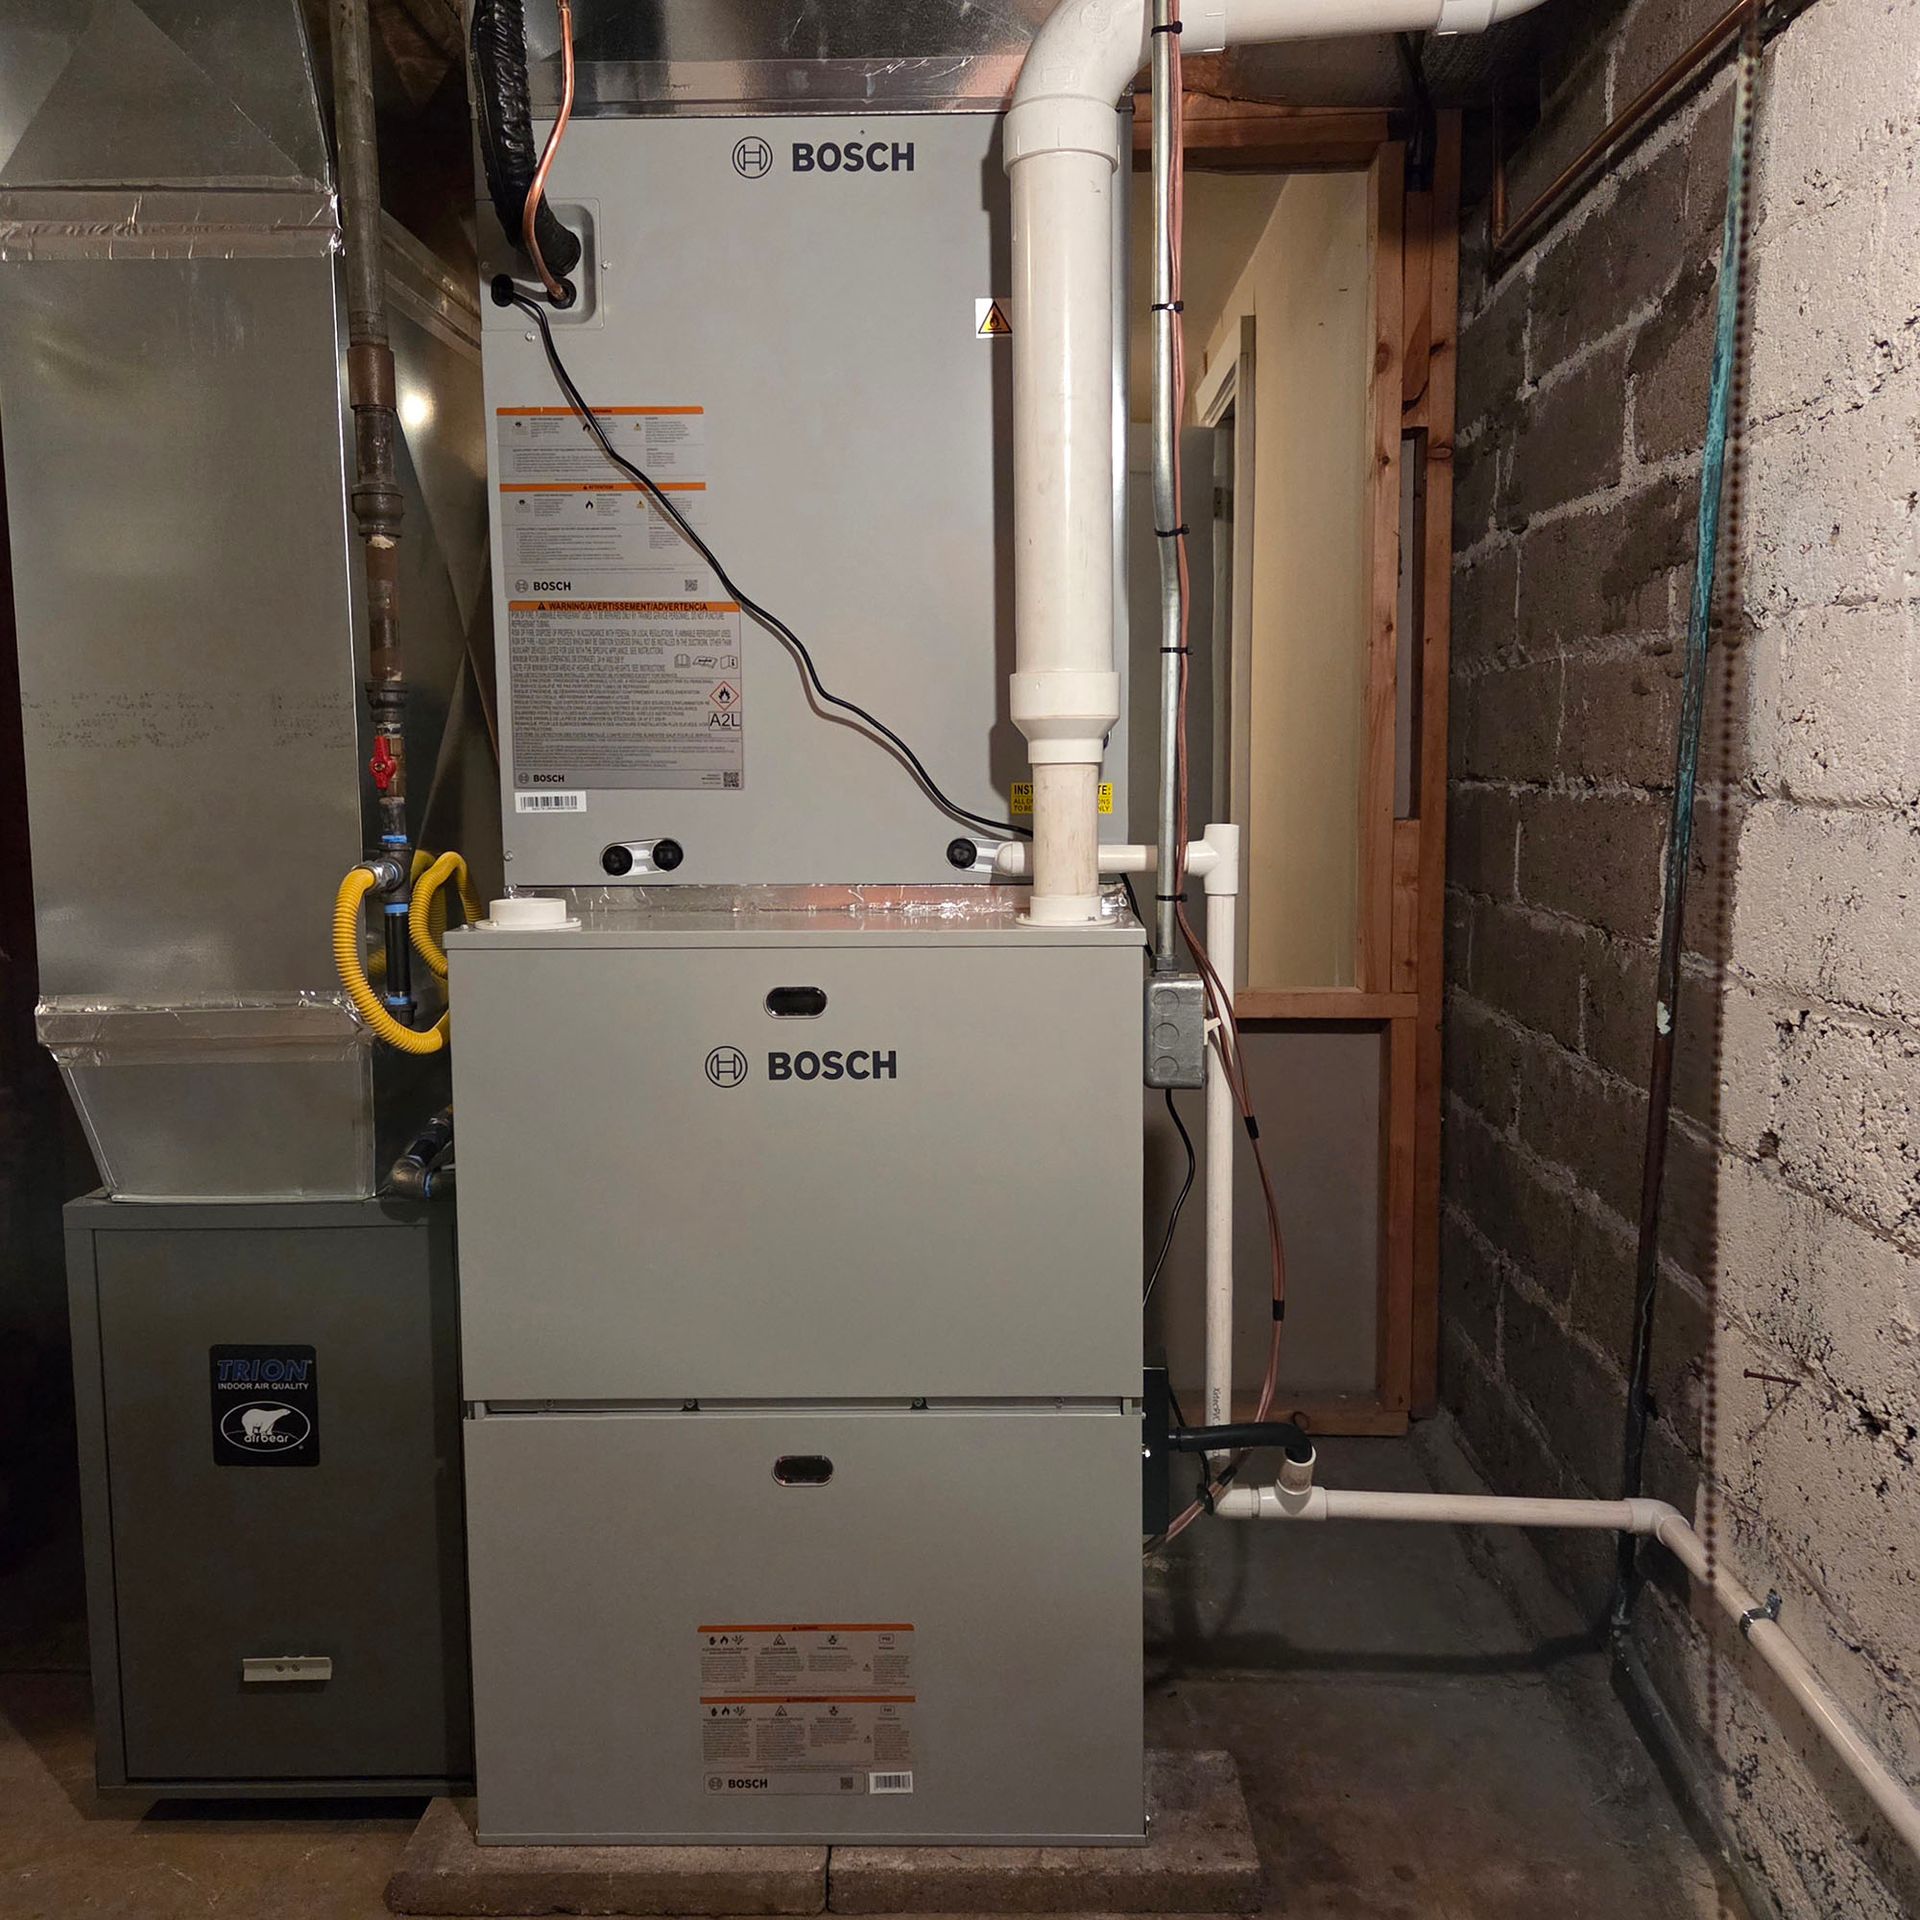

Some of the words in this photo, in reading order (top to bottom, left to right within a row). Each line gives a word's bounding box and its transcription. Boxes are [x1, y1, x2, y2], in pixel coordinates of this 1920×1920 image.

[792, 142, 915, 172] BOSCH
[533, 581, 572, 591] BOSCH
[549, 602, 708, 611] WARNING/AVERTISSEMENT/ADVERTENCIA
[709, 713, 740, 727] A2L
[533, 774, 565, 783] BOSCH
[1014, 785, 1033, 795] INST
[1097, 785, 1111, 795] TE:
[768, 1050, 897, 1080] BOSCH
[217, 1359, 309, 1382] TRION
[244, 1433, 289, 1443] airbear
[727, 1778, 768, 1789] BOSCH
